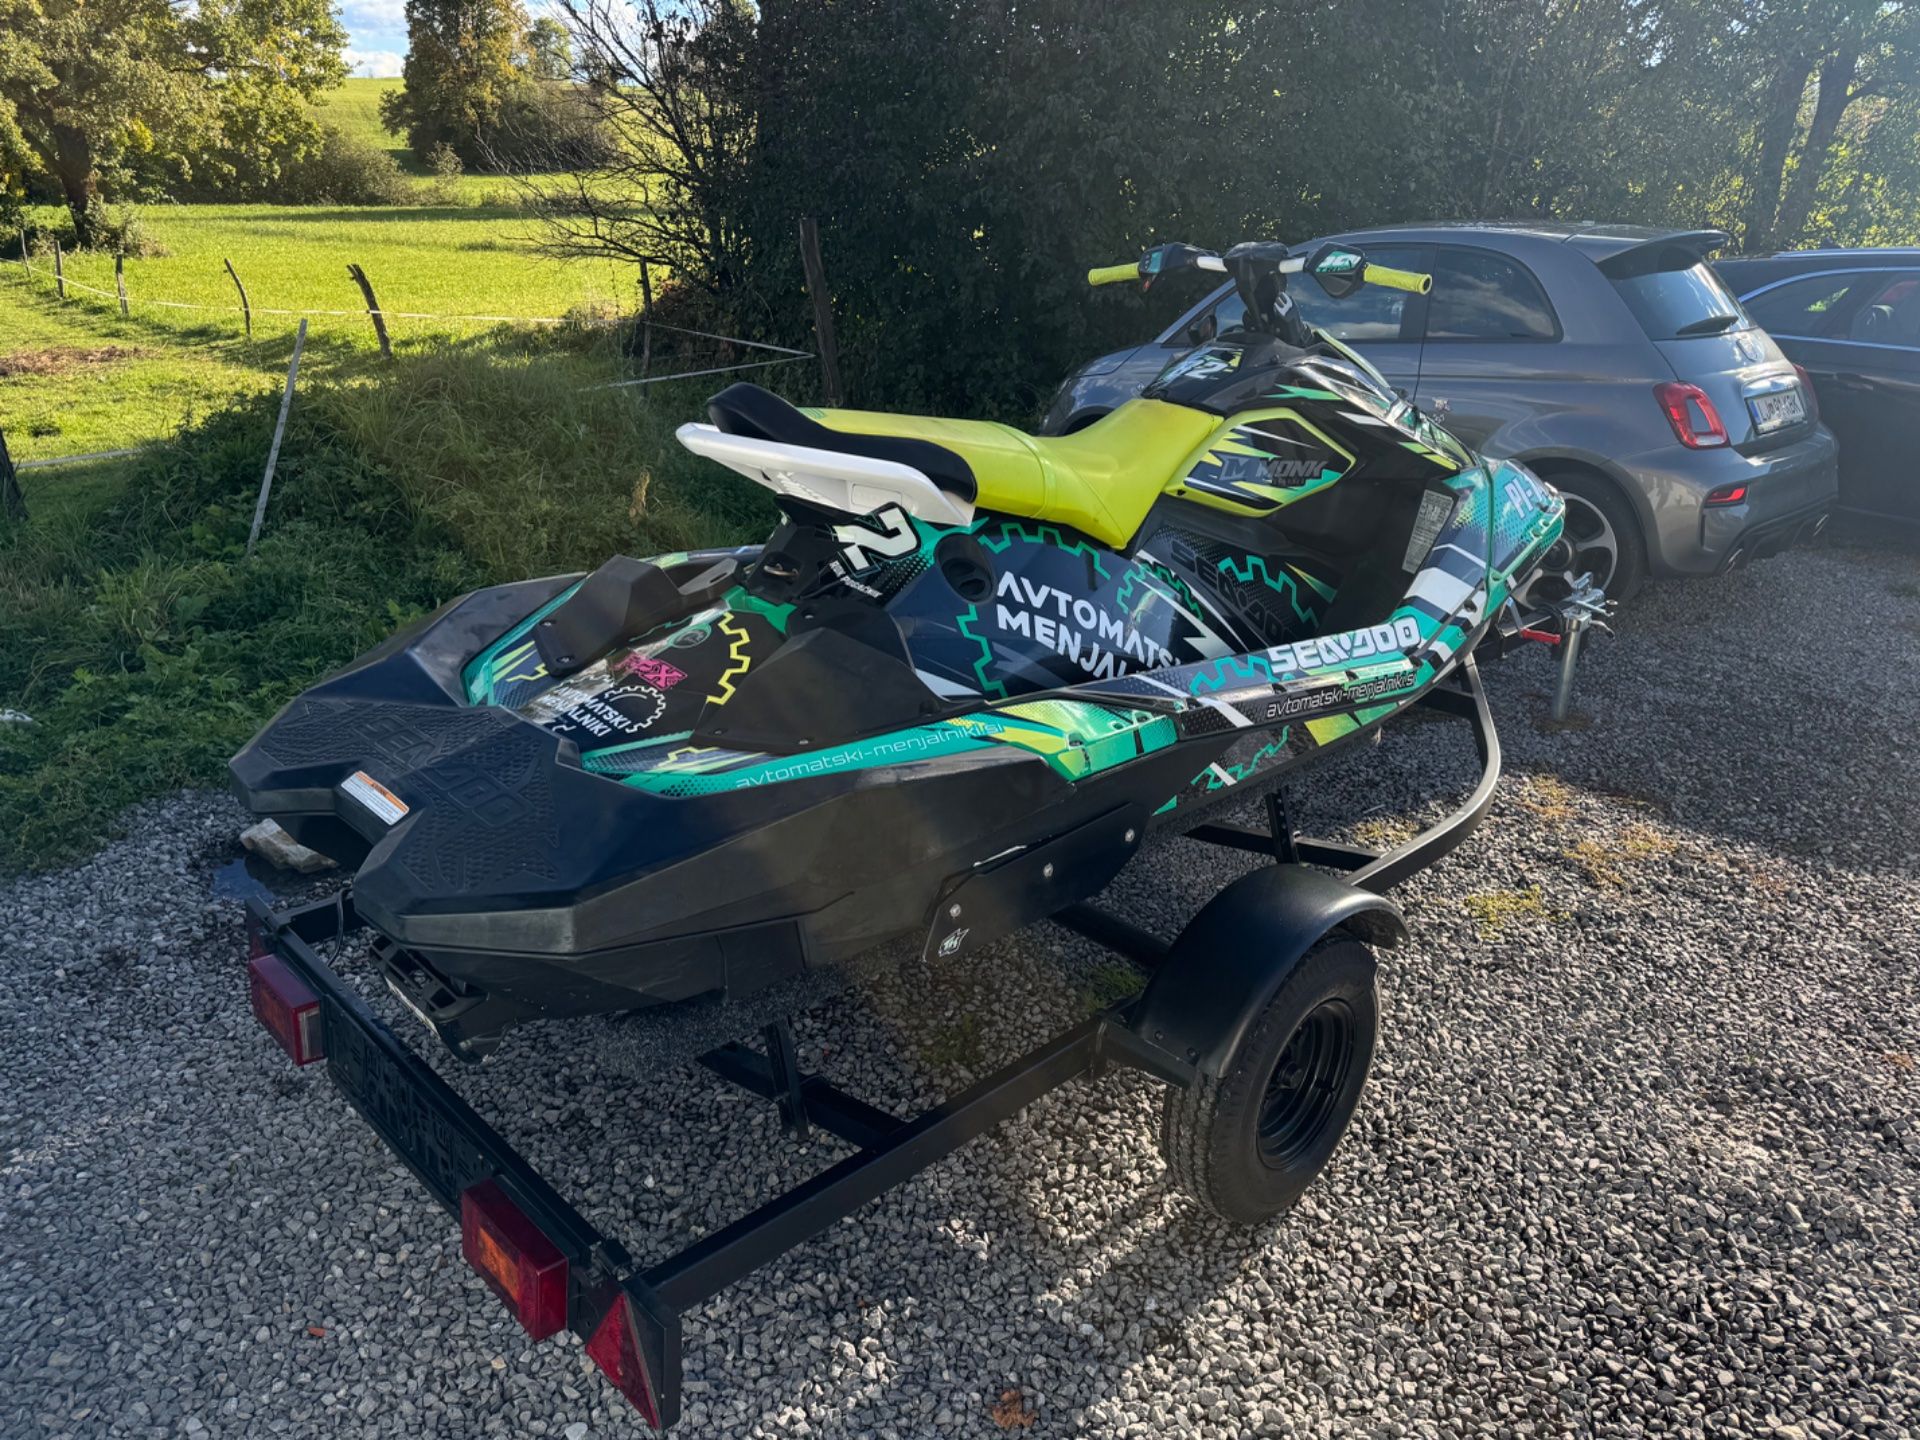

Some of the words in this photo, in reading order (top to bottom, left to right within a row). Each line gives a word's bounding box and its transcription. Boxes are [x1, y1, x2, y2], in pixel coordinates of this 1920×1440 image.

[1256, 459, 1328, 480] MONK
[997, 571, 1181, 669] AVTOMATS
[736, 723, 1005, 788] avtomatski-menjalniki.si
